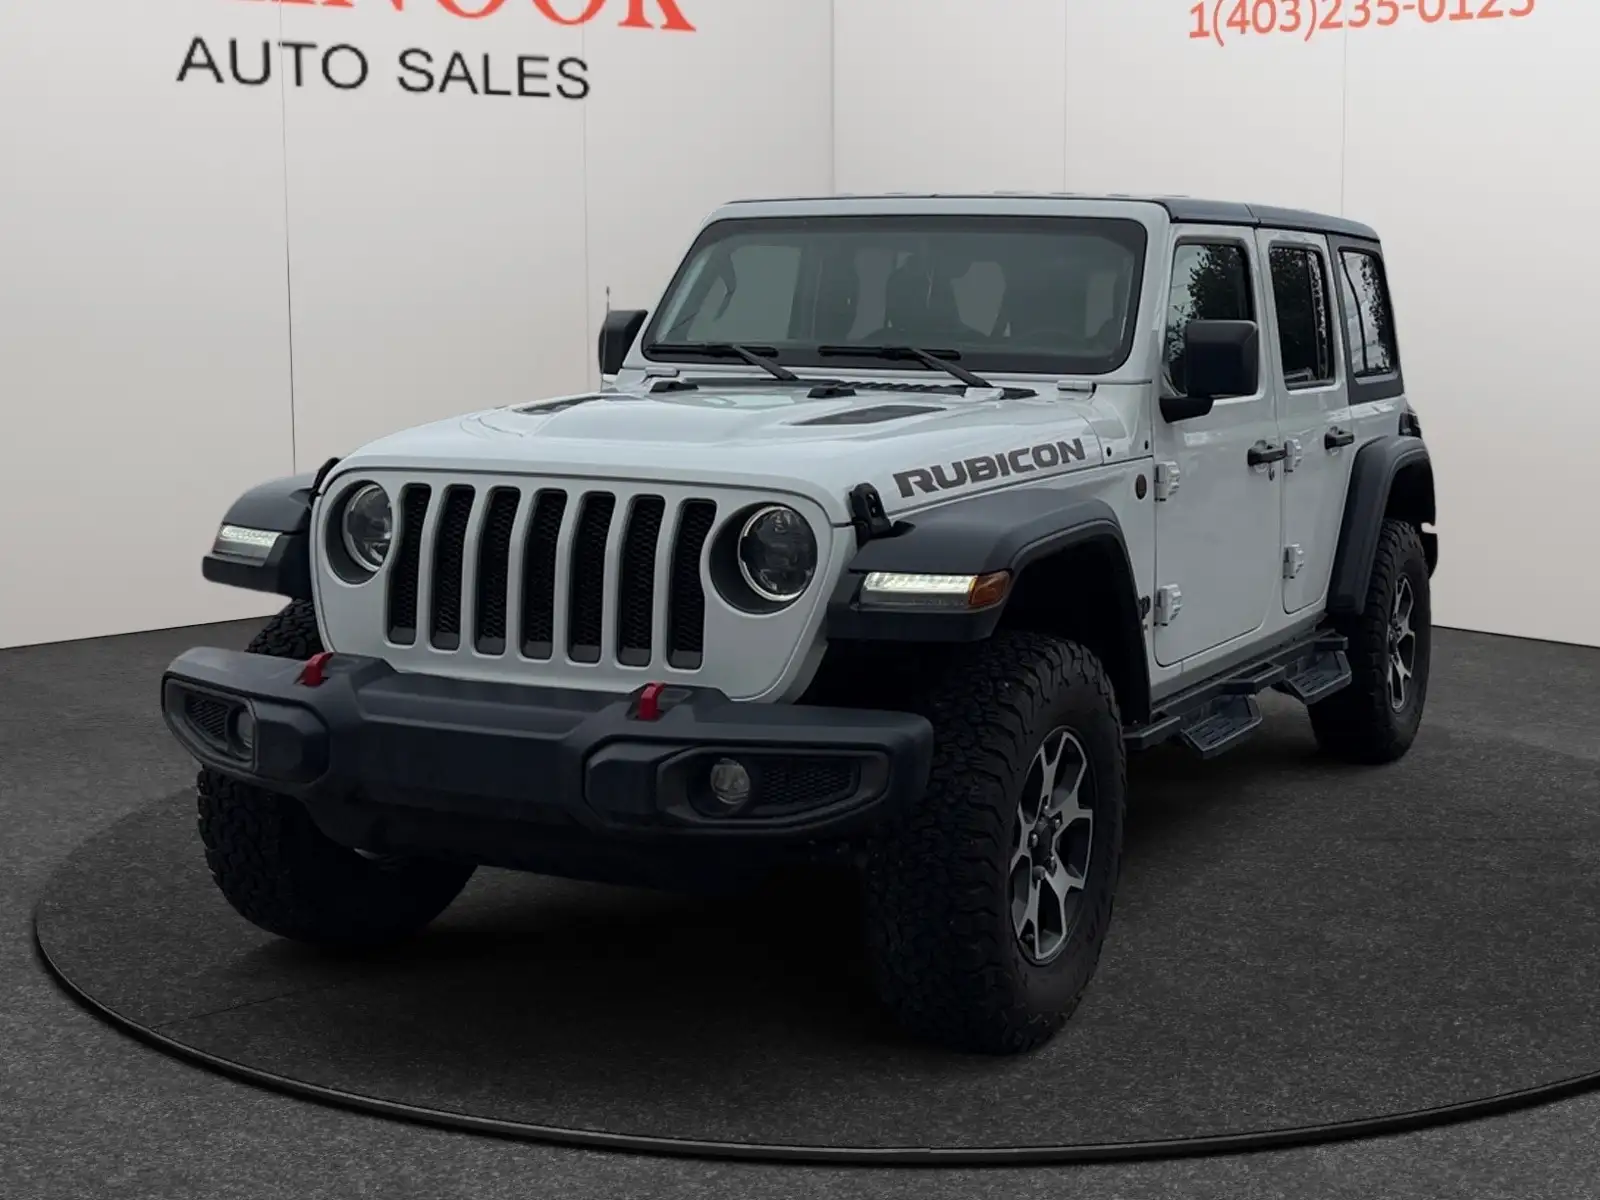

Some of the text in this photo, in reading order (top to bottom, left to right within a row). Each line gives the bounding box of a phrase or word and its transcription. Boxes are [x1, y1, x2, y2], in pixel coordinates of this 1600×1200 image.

[176, 36, 590, 100] AUTO SALES
[893, 437, 1086, 498] RUBICON
